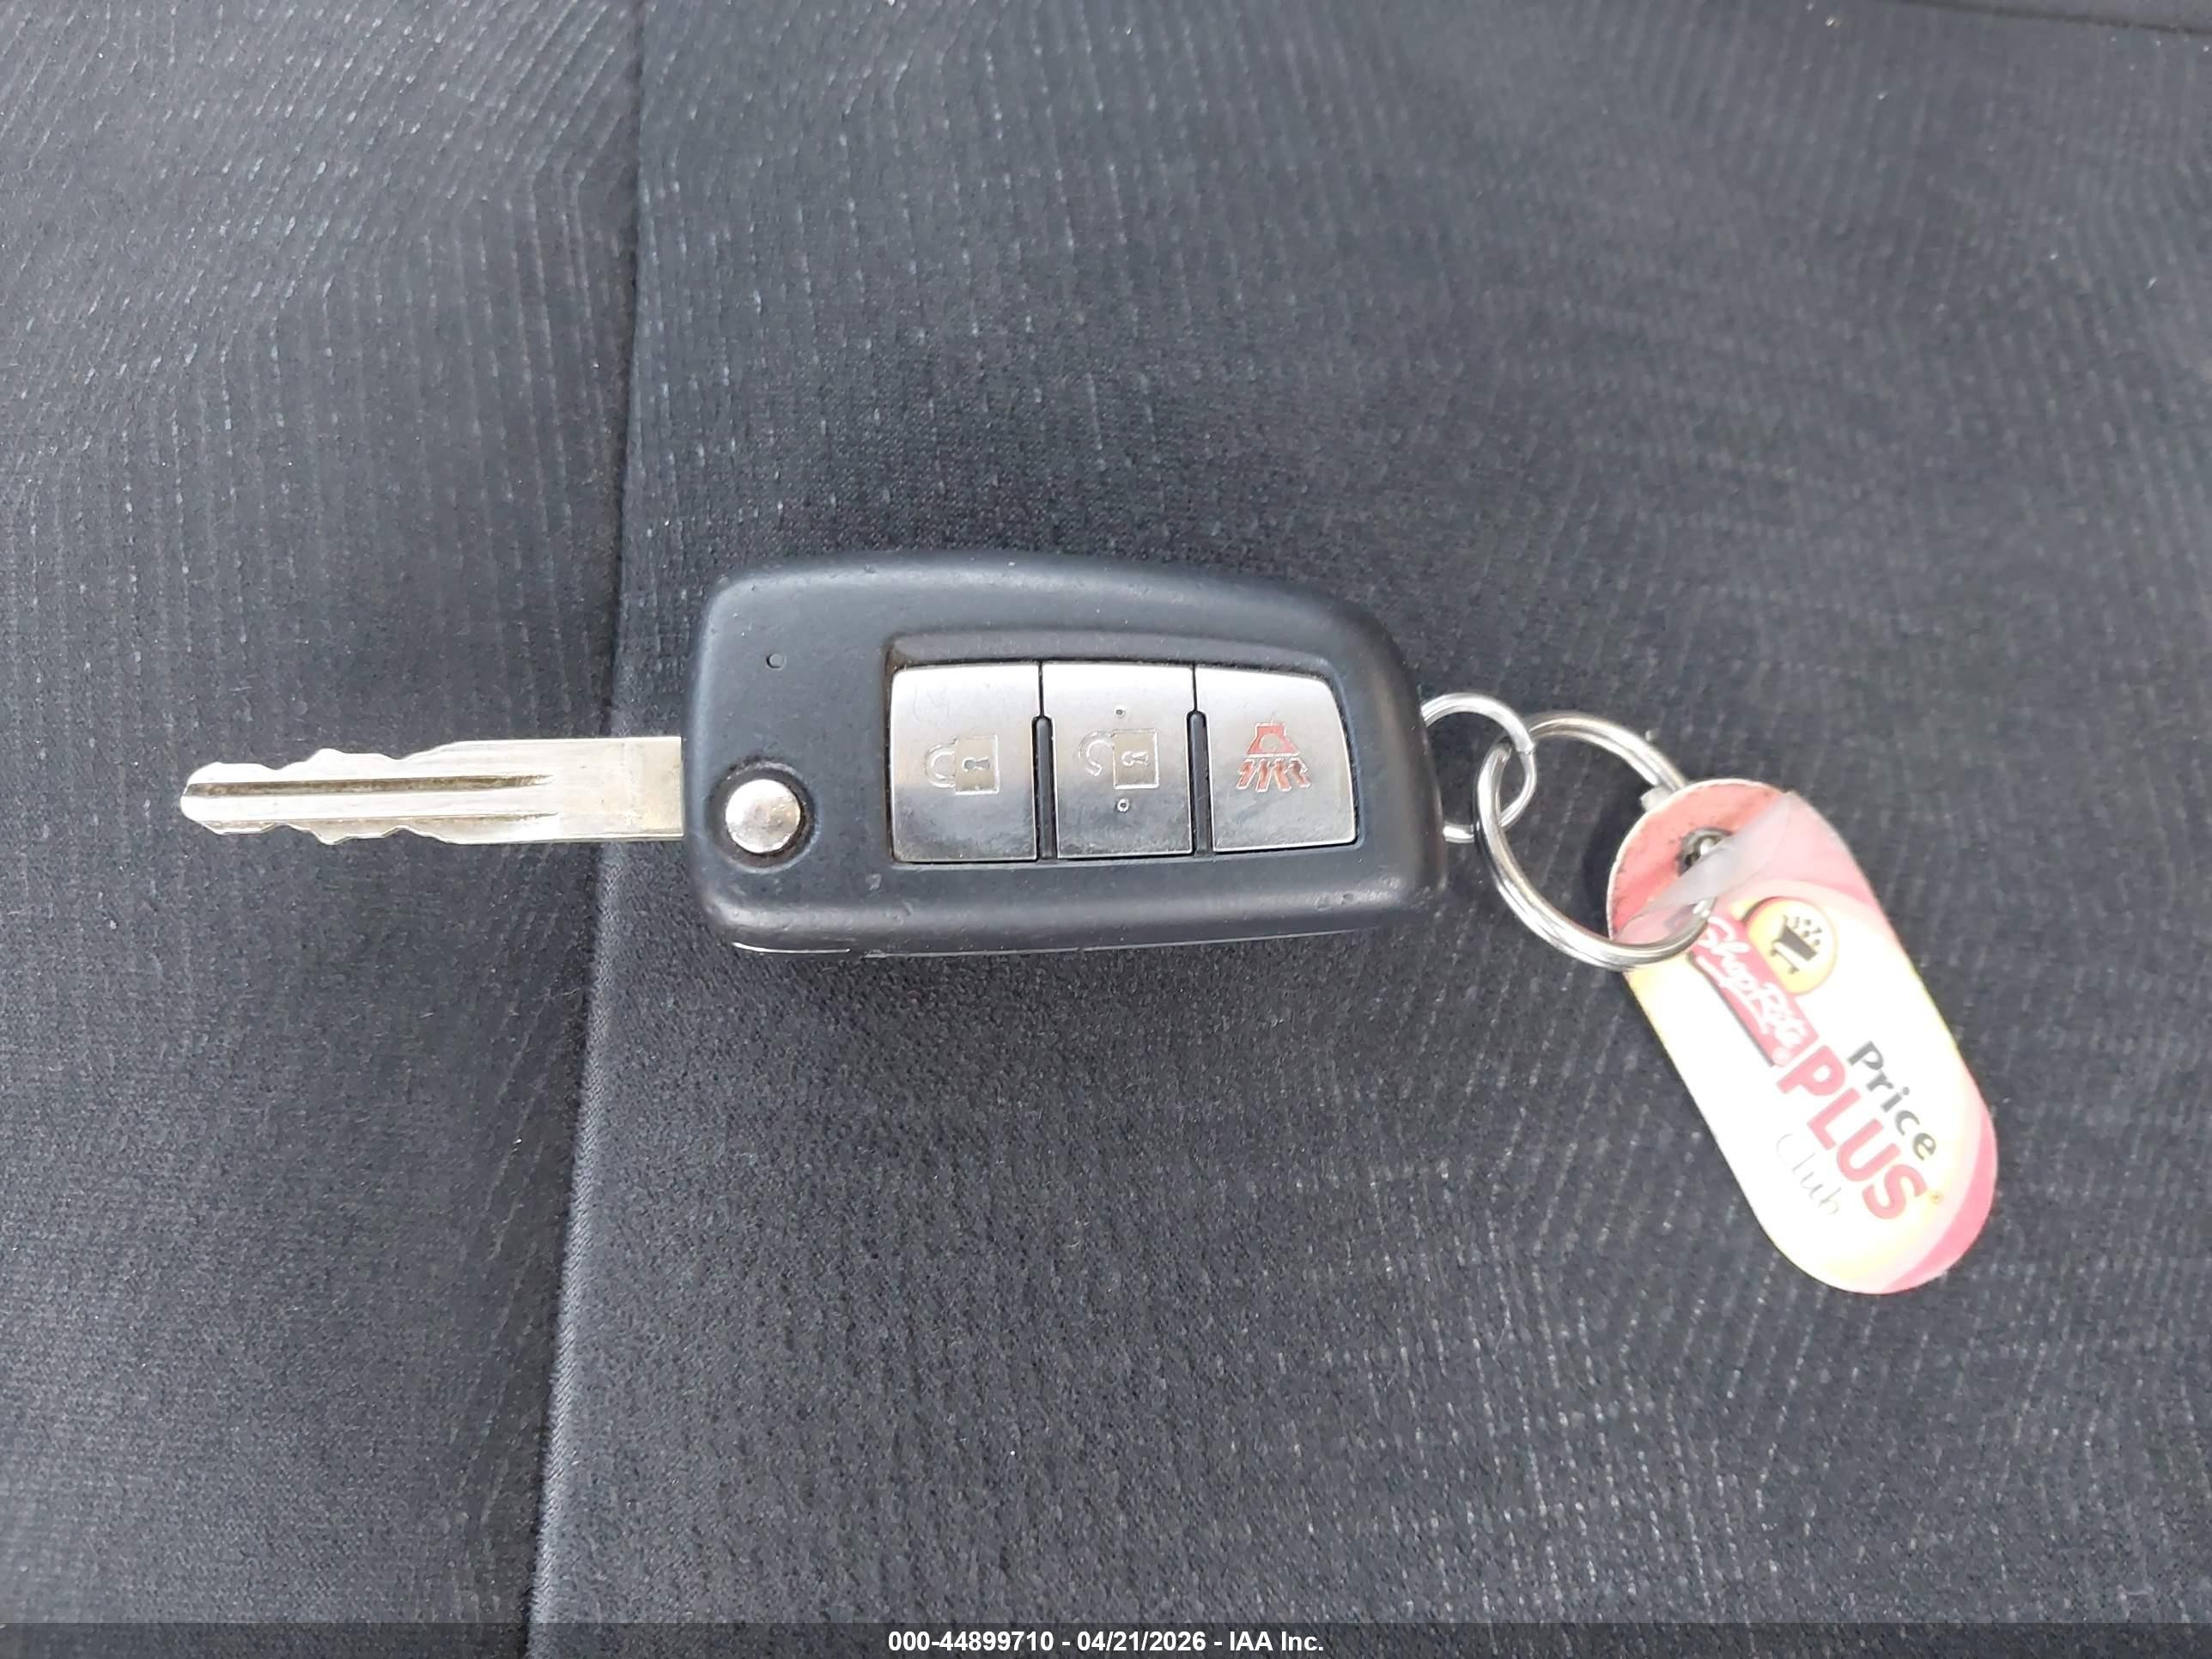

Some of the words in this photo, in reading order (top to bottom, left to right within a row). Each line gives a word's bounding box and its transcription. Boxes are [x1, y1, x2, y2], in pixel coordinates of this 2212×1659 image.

[1777, 1045, 1928, 1219] PLUS
[1847, 1041, 1937, 1162] Price
[1777, 1133, 1841, 1216] Club
